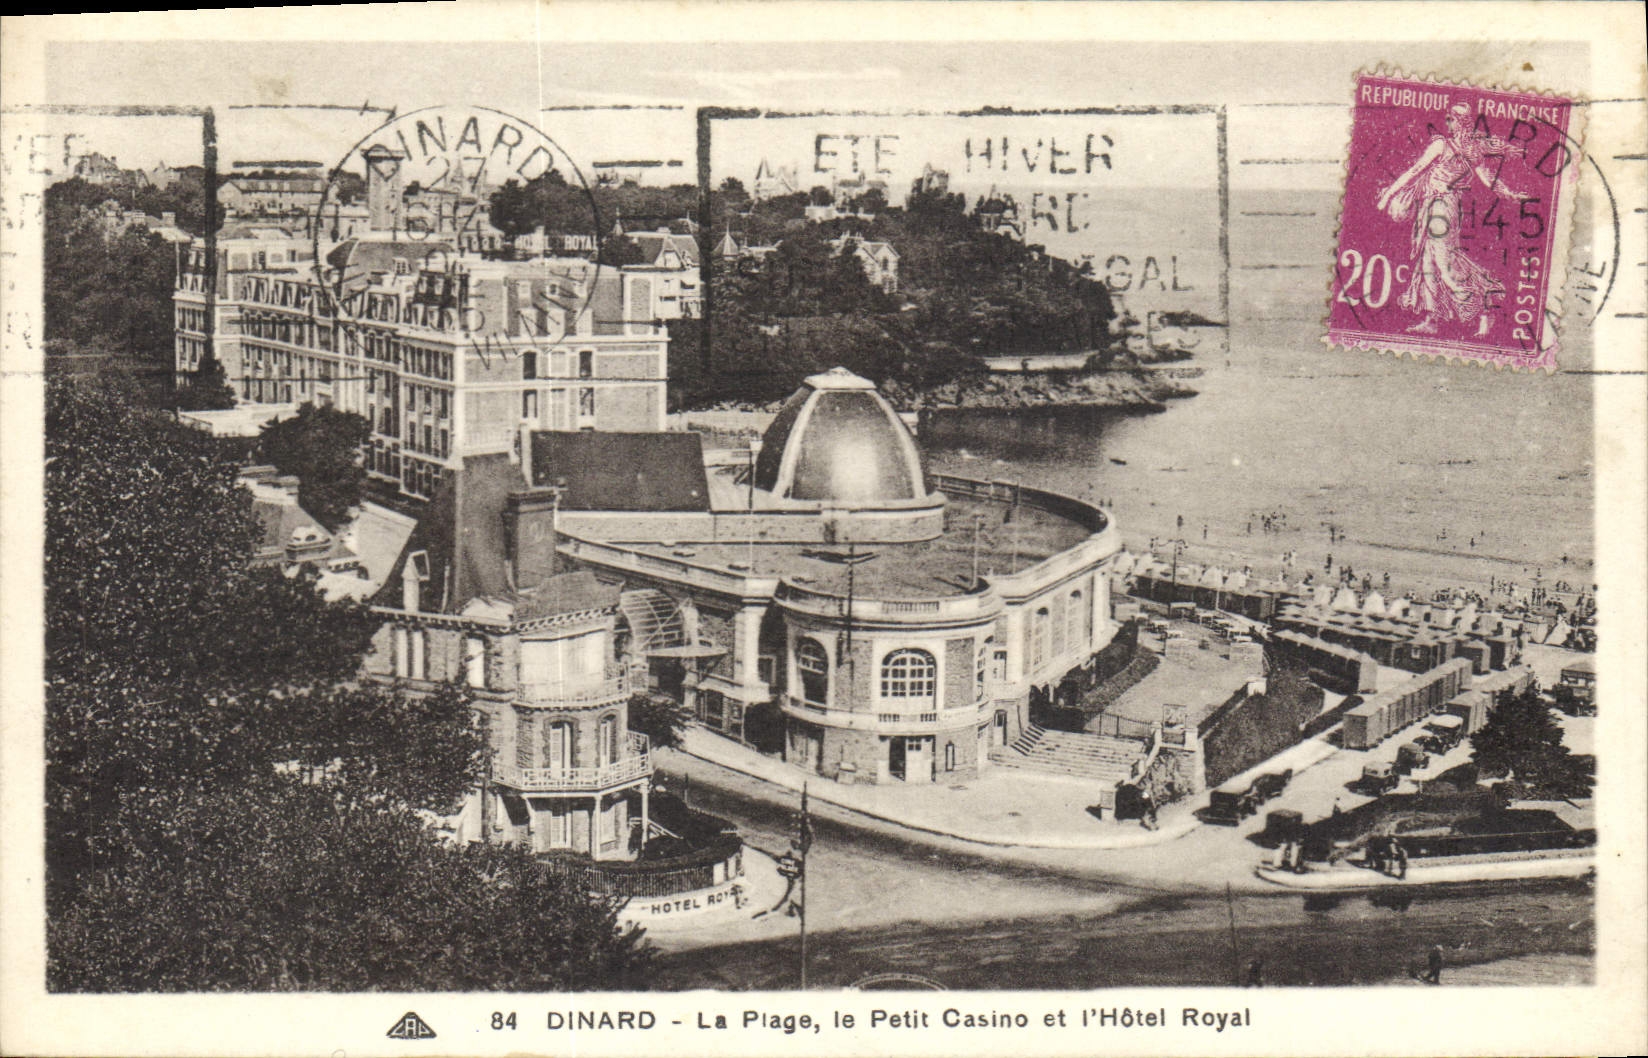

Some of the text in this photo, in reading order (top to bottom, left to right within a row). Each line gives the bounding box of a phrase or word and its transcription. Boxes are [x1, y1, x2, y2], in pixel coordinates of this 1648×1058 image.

[364, 115, 554, 184] DINARD
[965, 133, 1114, 174] HIVER
[1512, 253, 1542, 342] POSTES
[651, 899, 701, 914] HOTEL
